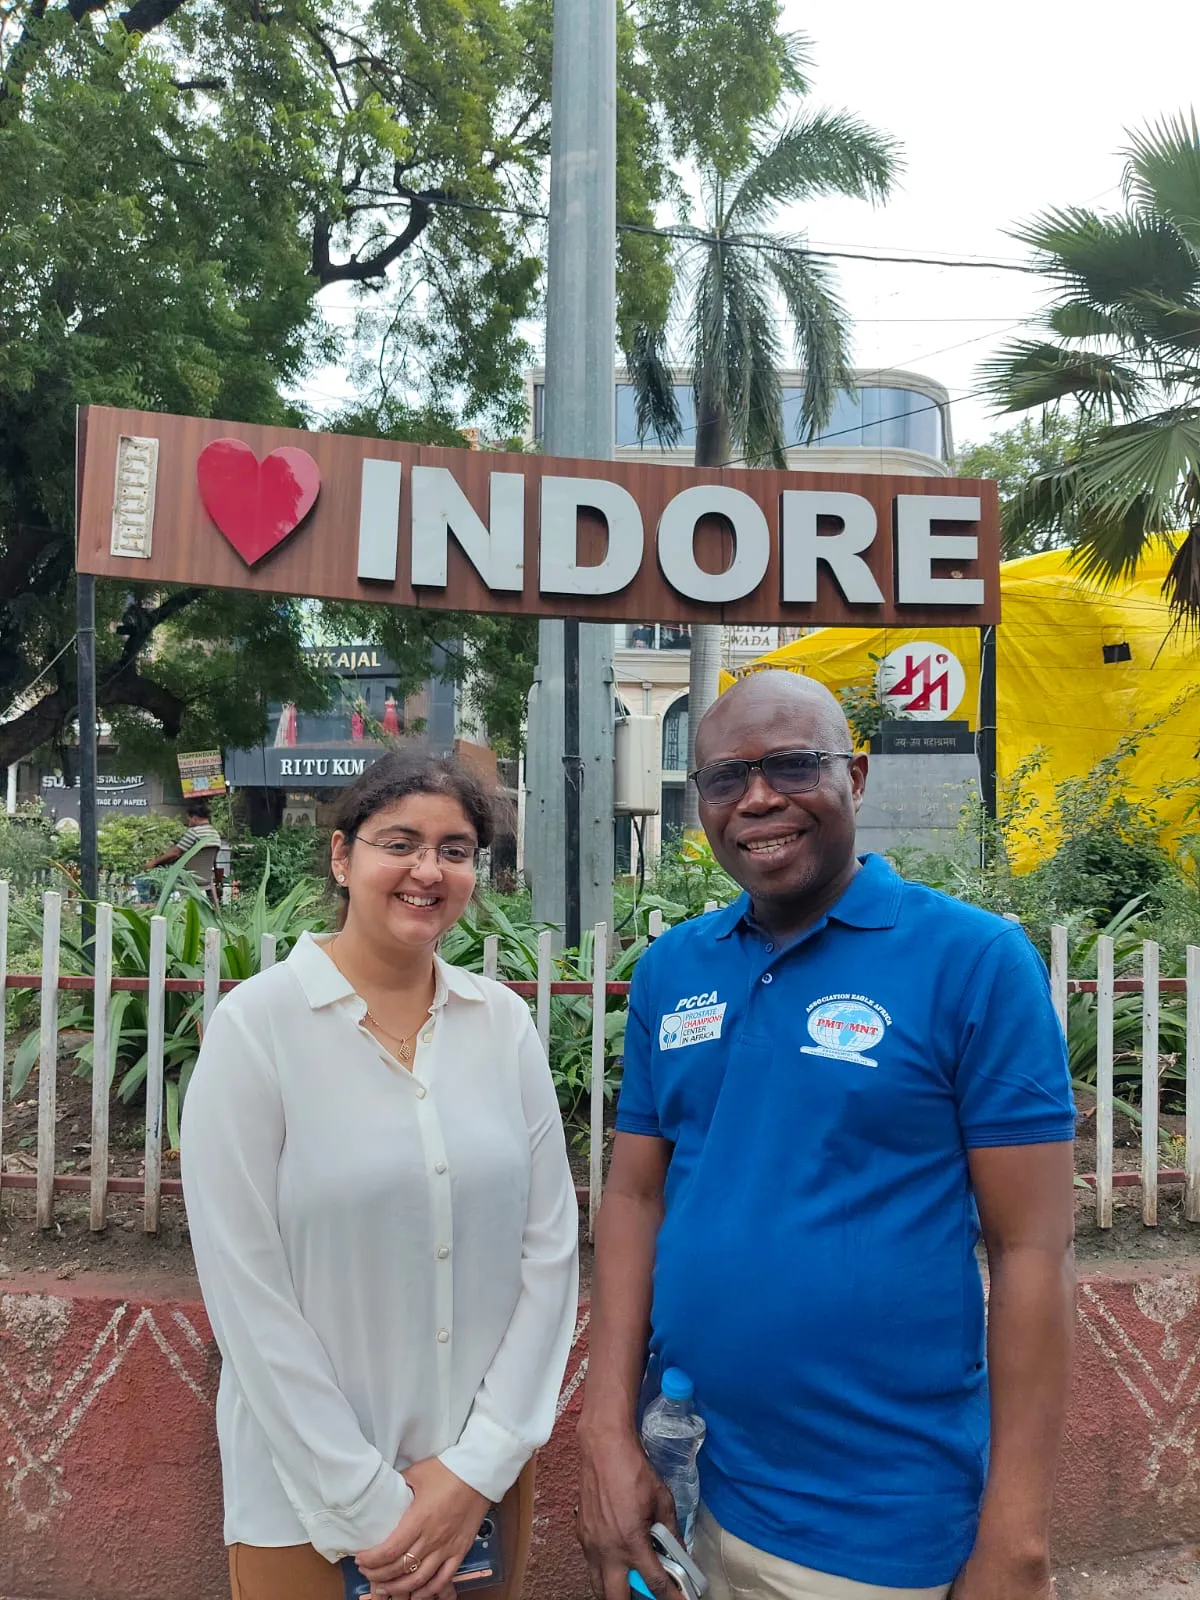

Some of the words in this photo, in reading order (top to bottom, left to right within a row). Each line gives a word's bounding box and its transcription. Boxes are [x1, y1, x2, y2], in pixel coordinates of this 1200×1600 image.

[357, 457, 985, 606] INDORE
[280, 758, 328, 776] RITU
[331, 758, 375, 776] KUM
[674, 989, 718, 1011] PCCA
[851, 993, 875, 1007] EAGLE
[873, 1003, 893, 1027] AFRICA
[682, 1036, 689, 1045] IN
[690, 1031, 714, 1043] AFRICA
